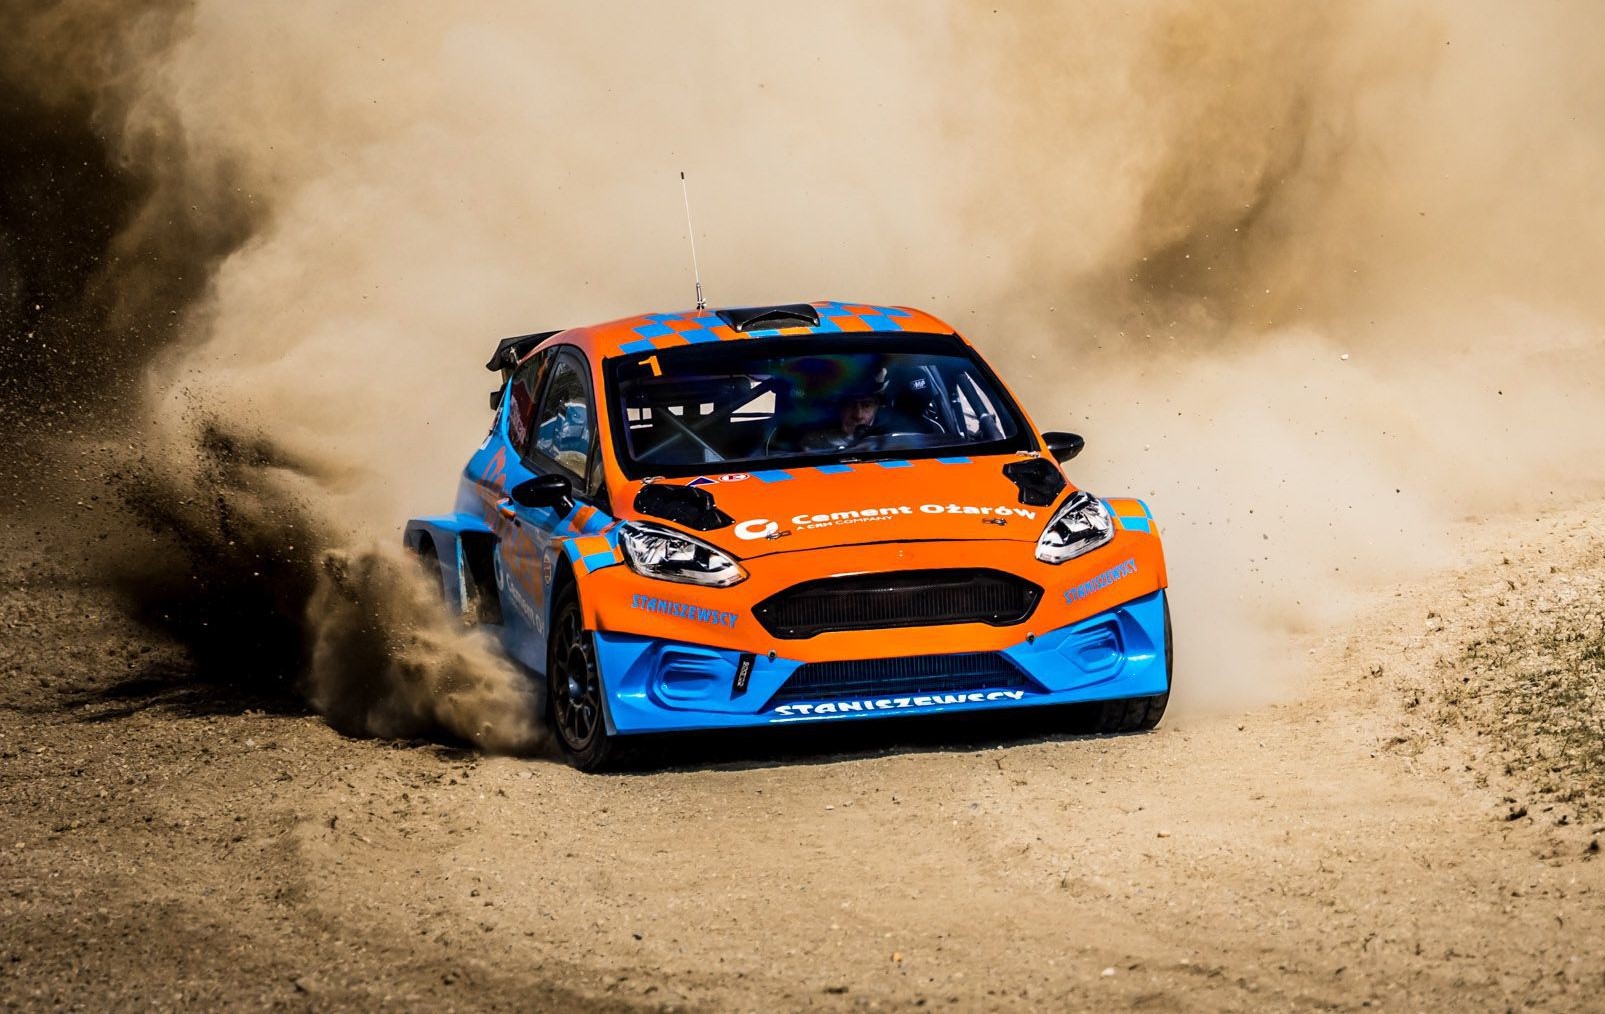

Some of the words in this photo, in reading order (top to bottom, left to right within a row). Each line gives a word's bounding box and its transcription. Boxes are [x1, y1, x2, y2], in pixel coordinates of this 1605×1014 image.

[638, 355, 662, 377] 1
[791, 504, 912, 525] Cement
[919, 503, 1036, 520] Ożarów
[835, 515, 893, 526] COMPANY
[1063, 557, 1138, 605] STANISZEWSCY
[631, 593, 739, 629] STANISZEWSCY
[774, 691, 1024, 716] STANISZEWSCY
